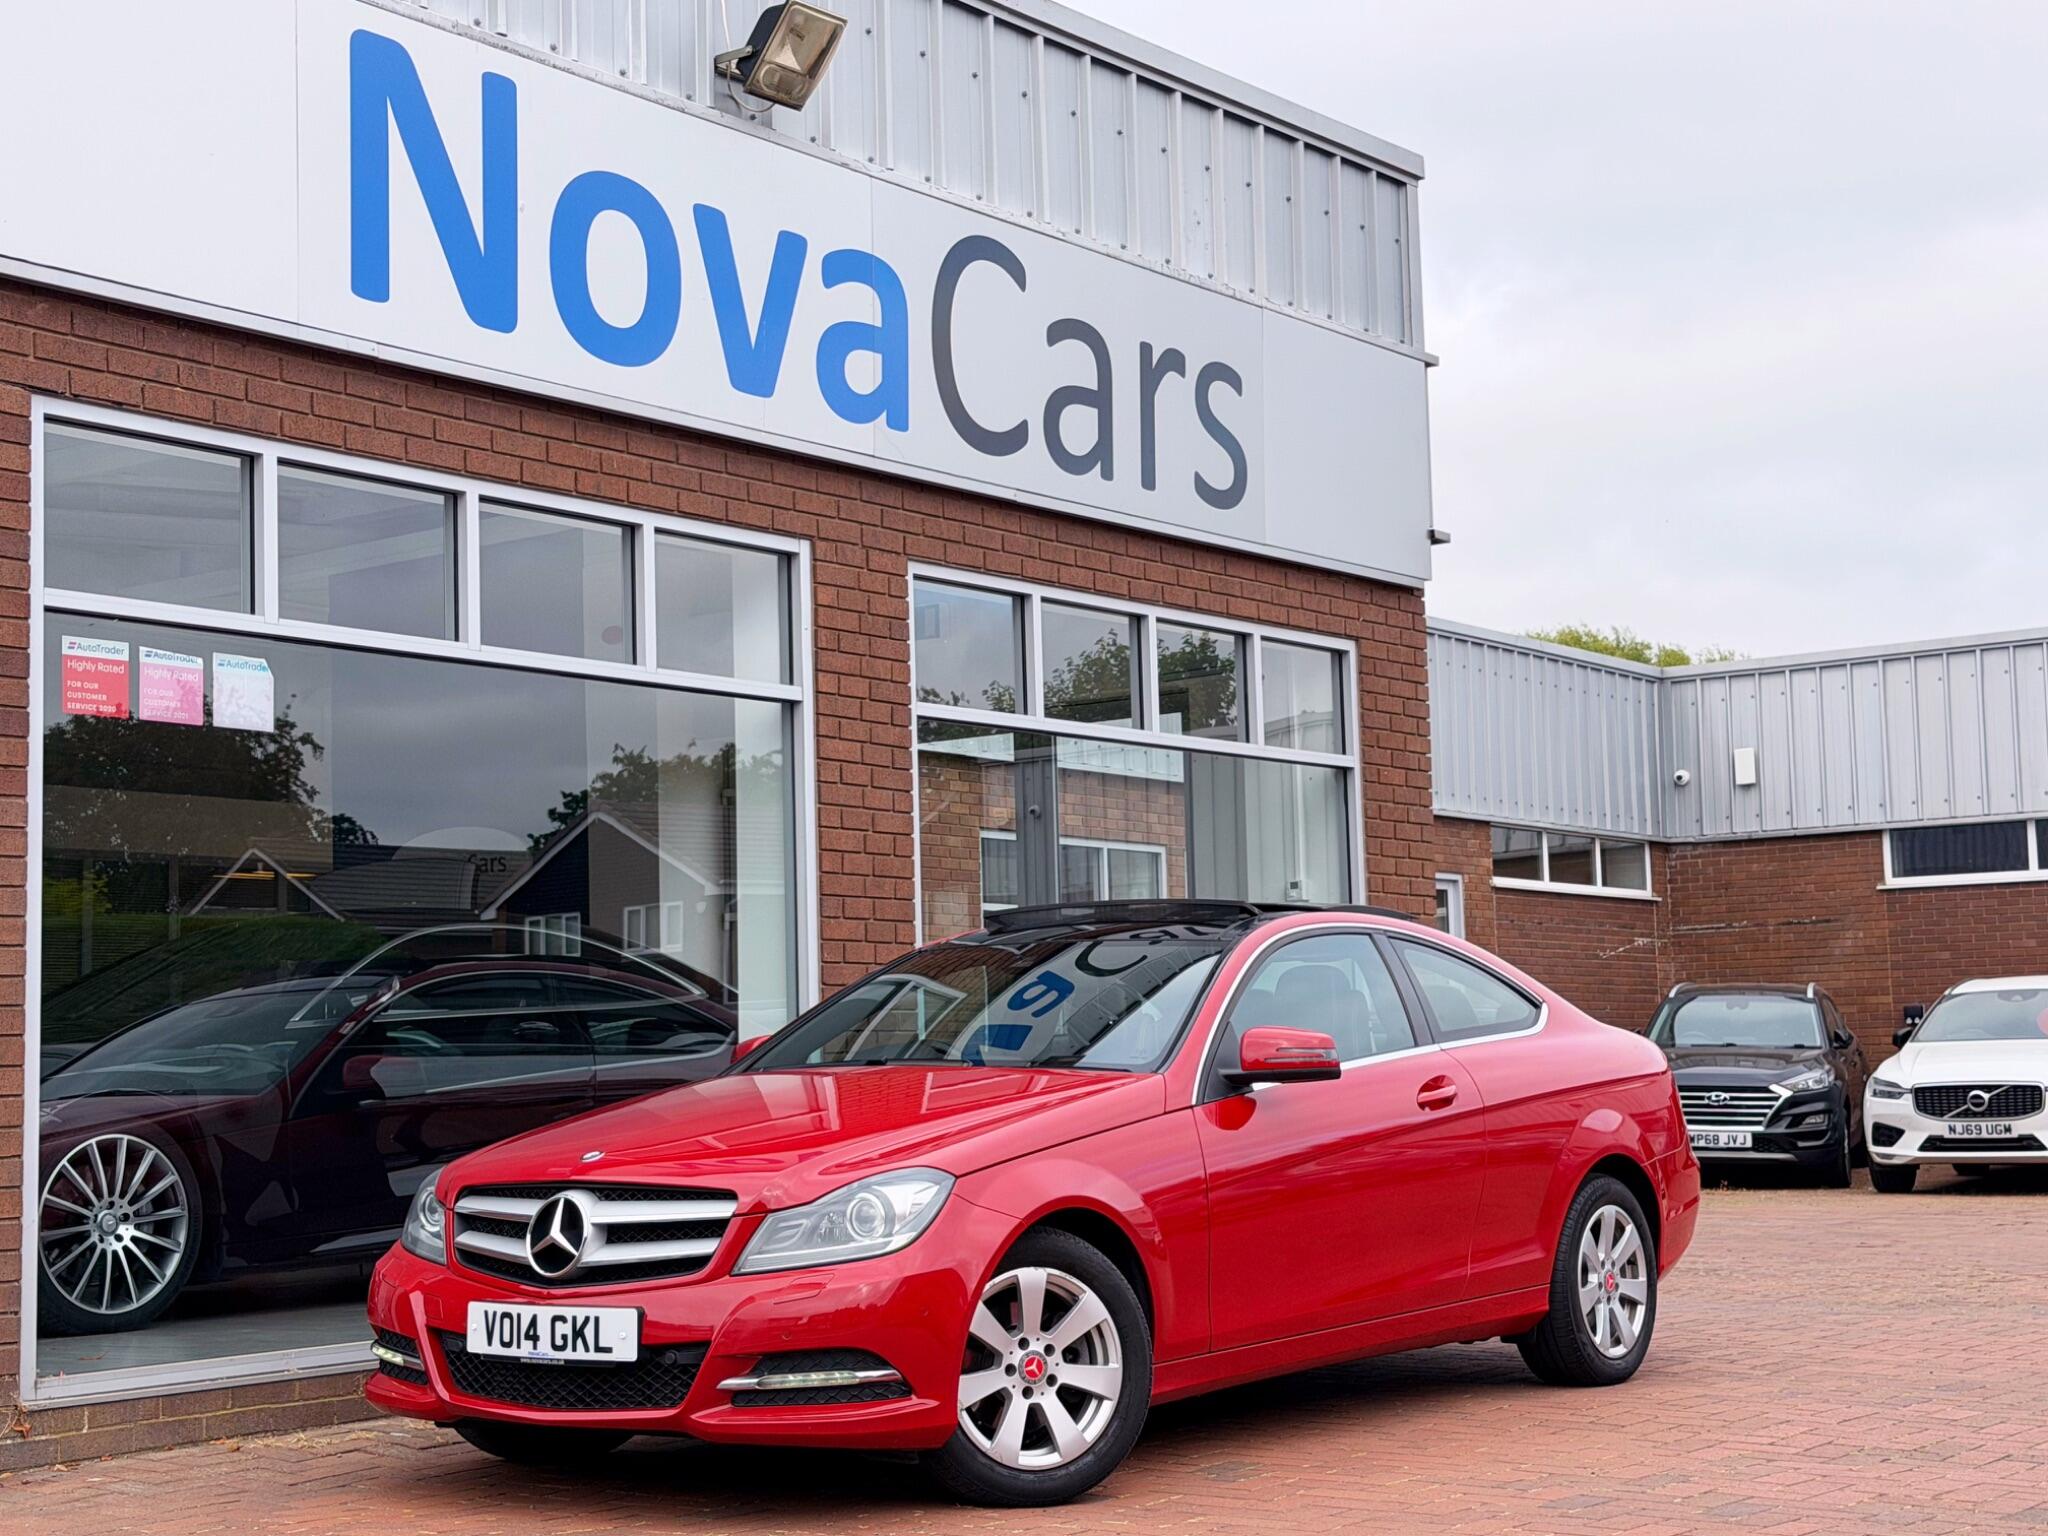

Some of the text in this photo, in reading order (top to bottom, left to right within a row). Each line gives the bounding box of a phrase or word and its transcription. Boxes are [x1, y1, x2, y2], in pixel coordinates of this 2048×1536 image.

[350, 28, 1249, 511] NovaCars
[77, 643, 126, 656] AutoTrader
[67, 659, 125, 675] Highly Rated
[143, 665, 172, 681] Highly
[67, 680, 99, 690] FOR OUR
[67, 691, 107, 701] CUSTOMER
[67, 701, 117, 713] SERVICE 2020
[1948, 1122, 2012, 1136] NJ69 UGM
[1723, 1133, 1747, 1146] JVJ
[483, 1310, 614, 1354] VO14 GKL
